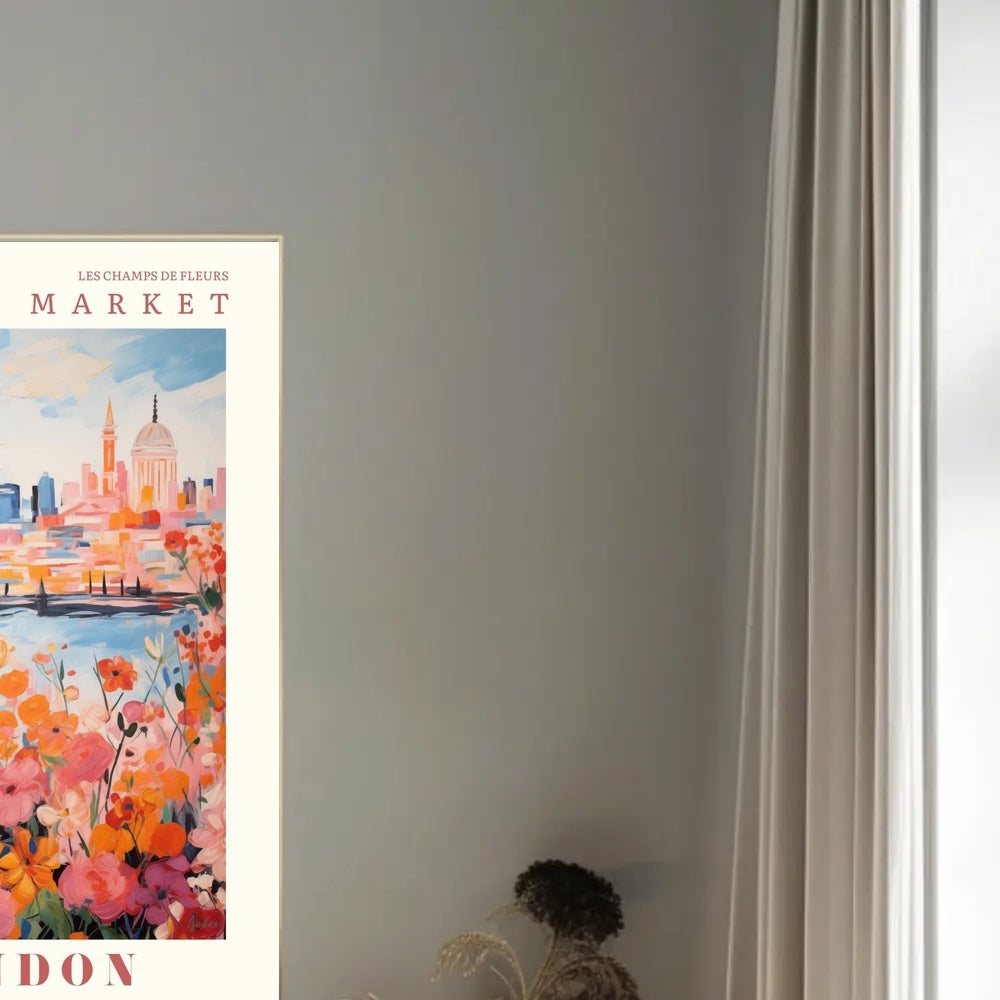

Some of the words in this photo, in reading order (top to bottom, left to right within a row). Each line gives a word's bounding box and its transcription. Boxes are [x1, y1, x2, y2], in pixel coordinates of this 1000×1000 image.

[78, 270, 101, 281] LES
[103, 270, 158, 281] CHAMPS
[160, 270, 178, 281] DE
[180, 270, 229, 281] FLEURS
[30, 293, 230, 315] MARKET
